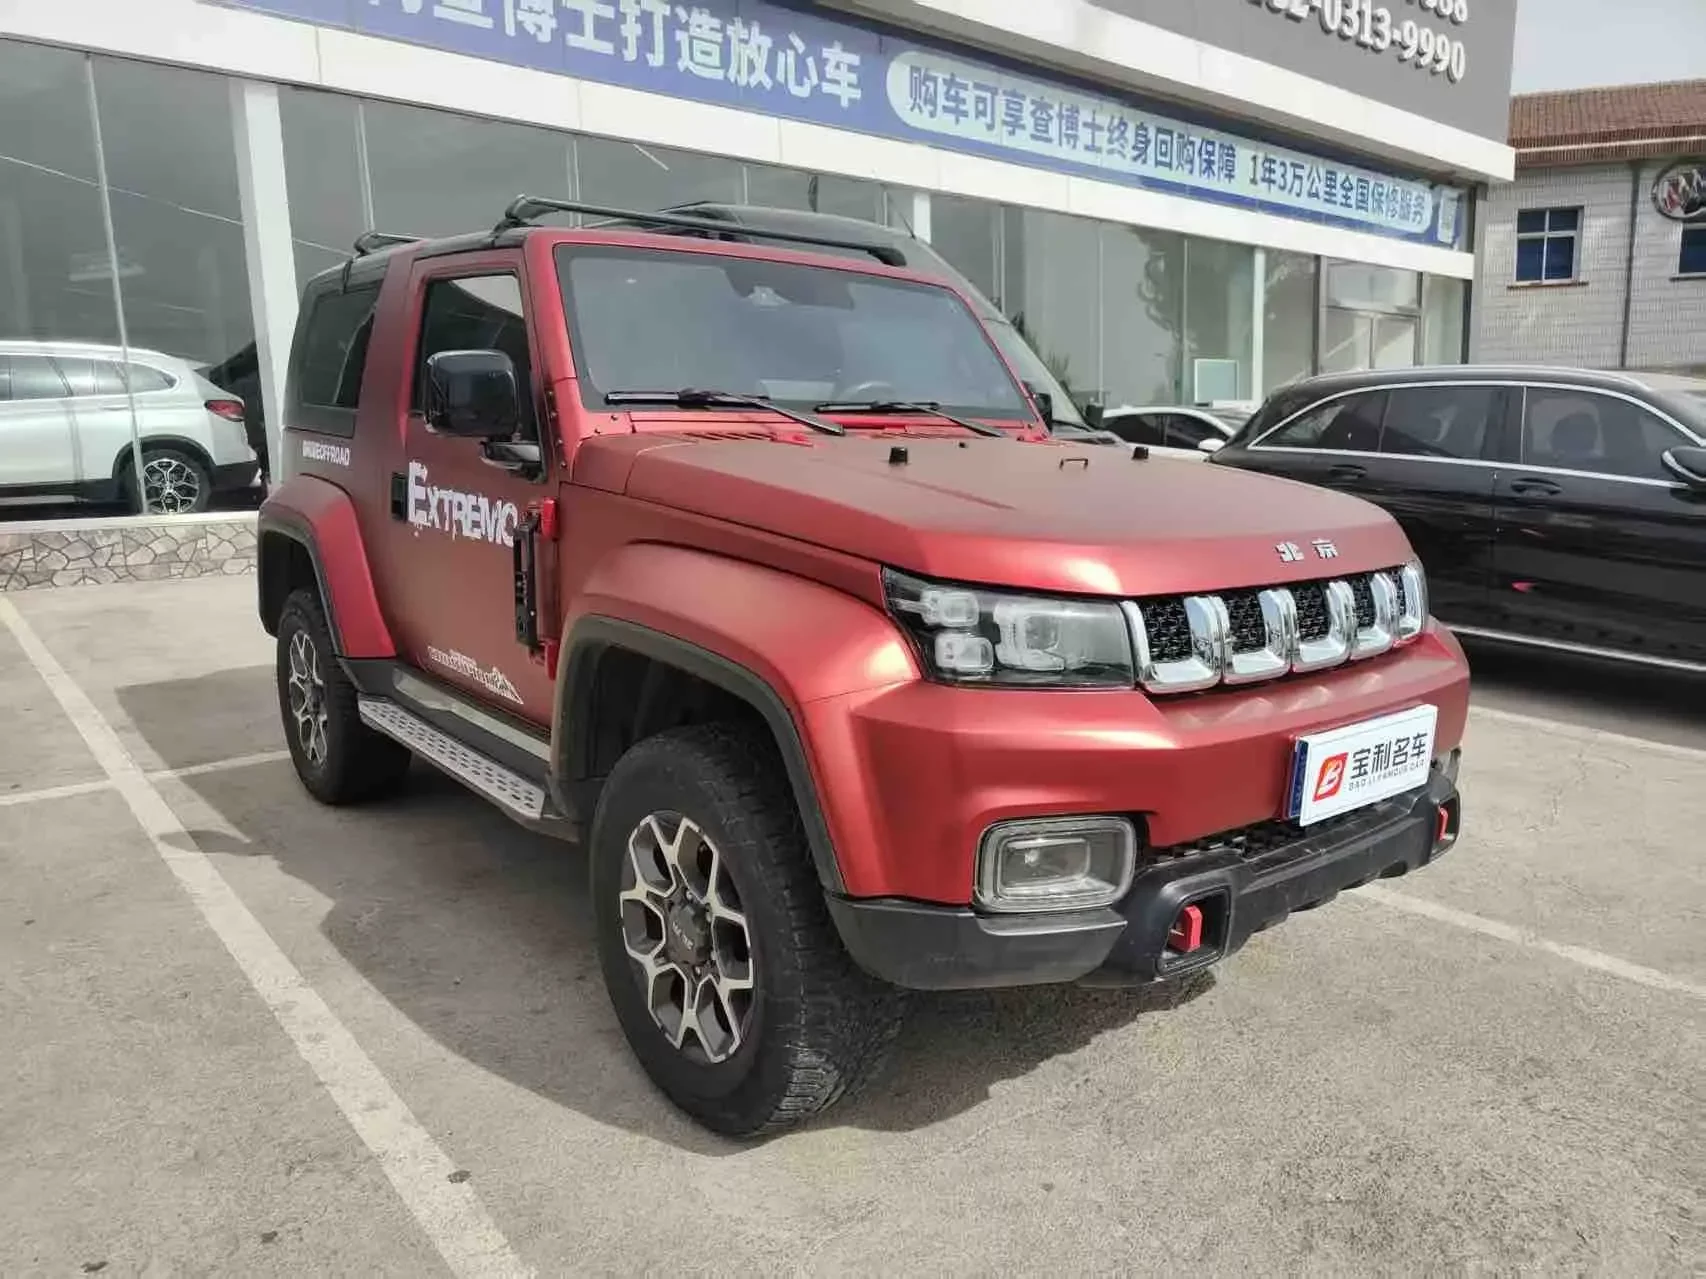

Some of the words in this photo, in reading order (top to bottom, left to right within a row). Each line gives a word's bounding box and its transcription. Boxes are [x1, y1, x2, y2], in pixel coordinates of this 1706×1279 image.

[369, 0, 862, 108] 博士打造放心车
[908, 65, 1237, 184] 购车可享查博士终身回购保障
[1275, 539, 1339, 563] 北京
[1350, 732, 1428, 780] 宝利名车
